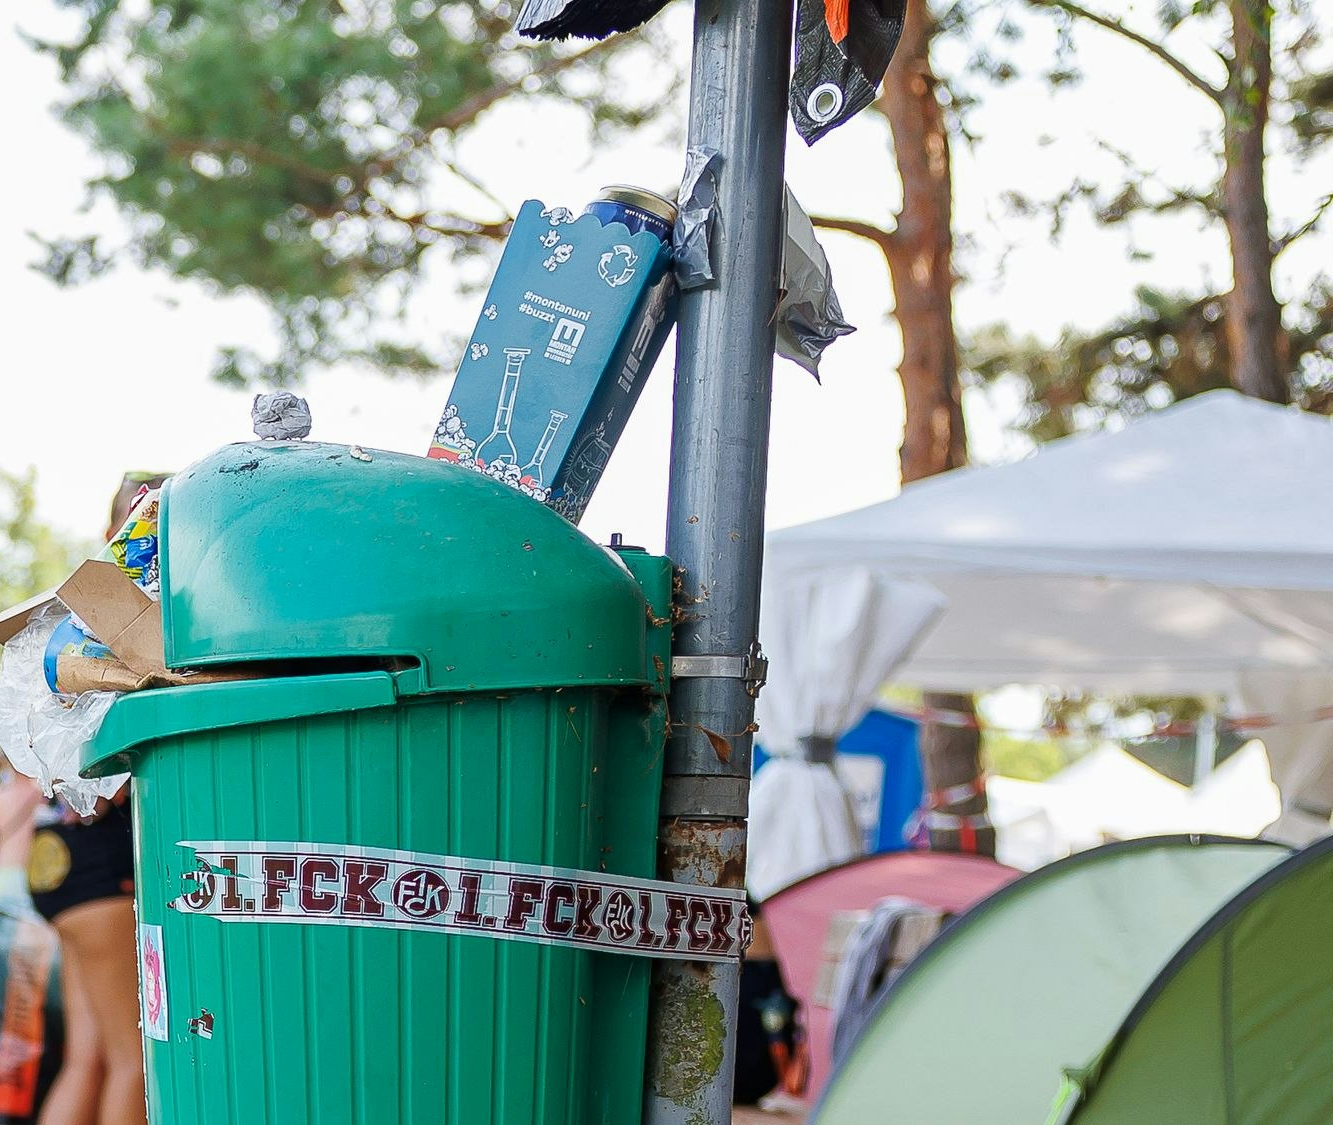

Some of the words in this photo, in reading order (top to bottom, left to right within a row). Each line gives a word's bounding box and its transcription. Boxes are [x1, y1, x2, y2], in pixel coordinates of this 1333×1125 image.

[518, 303, 556, 323] #buzzt
[523, 290, 592, 322] #montanuni
[548, 339, 578, 355] MONTAN
